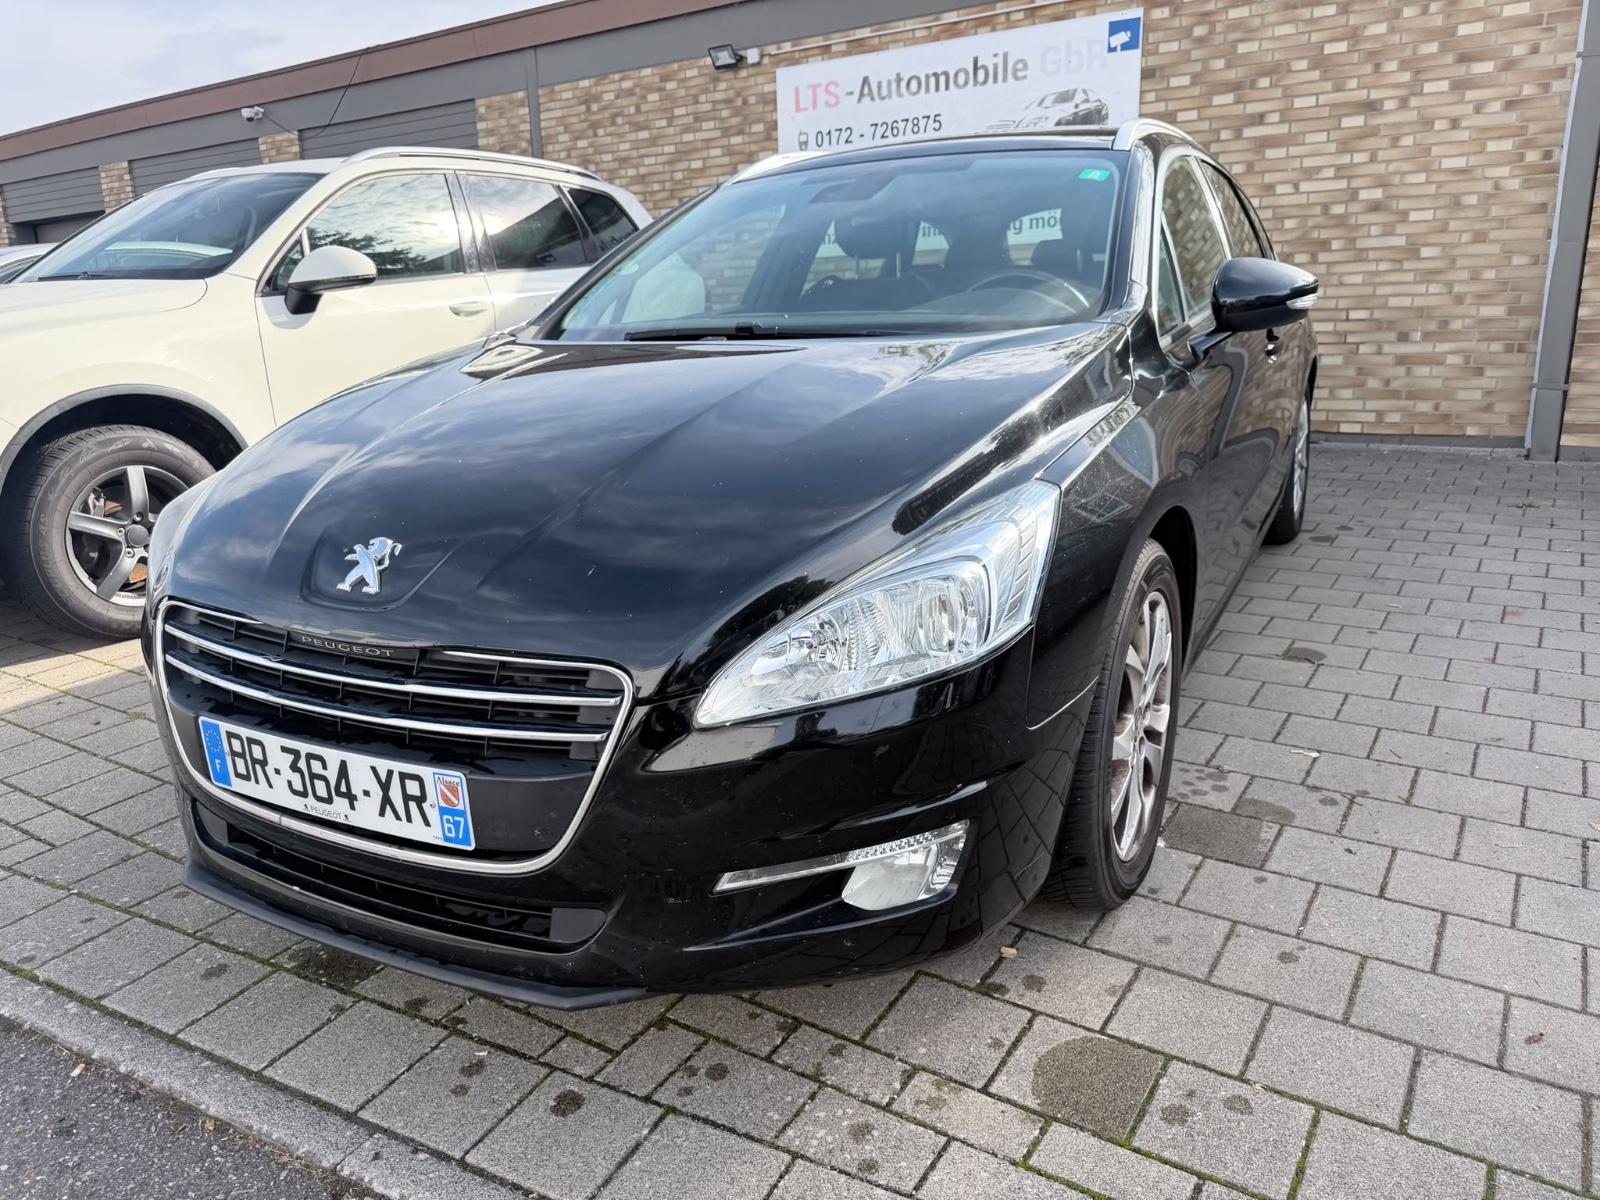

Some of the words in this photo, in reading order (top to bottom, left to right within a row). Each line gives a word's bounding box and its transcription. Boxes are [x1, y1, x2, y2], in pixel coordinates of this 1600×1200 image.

[1040, 39, 1110, 78] GbR
[815, 126, 853, 148] 0172
[870, 113, 943, 141] 7267875
[302, 636, 394, 657] PEUGEOT
[214, 758, 222, 773] F
[225, 730, 432, 828] BR-364-XR
[436, 776, 461, 787] Alsace
[310, 805, 342, 820] PEUGEOT
[442, 814, 465, 839] 67
